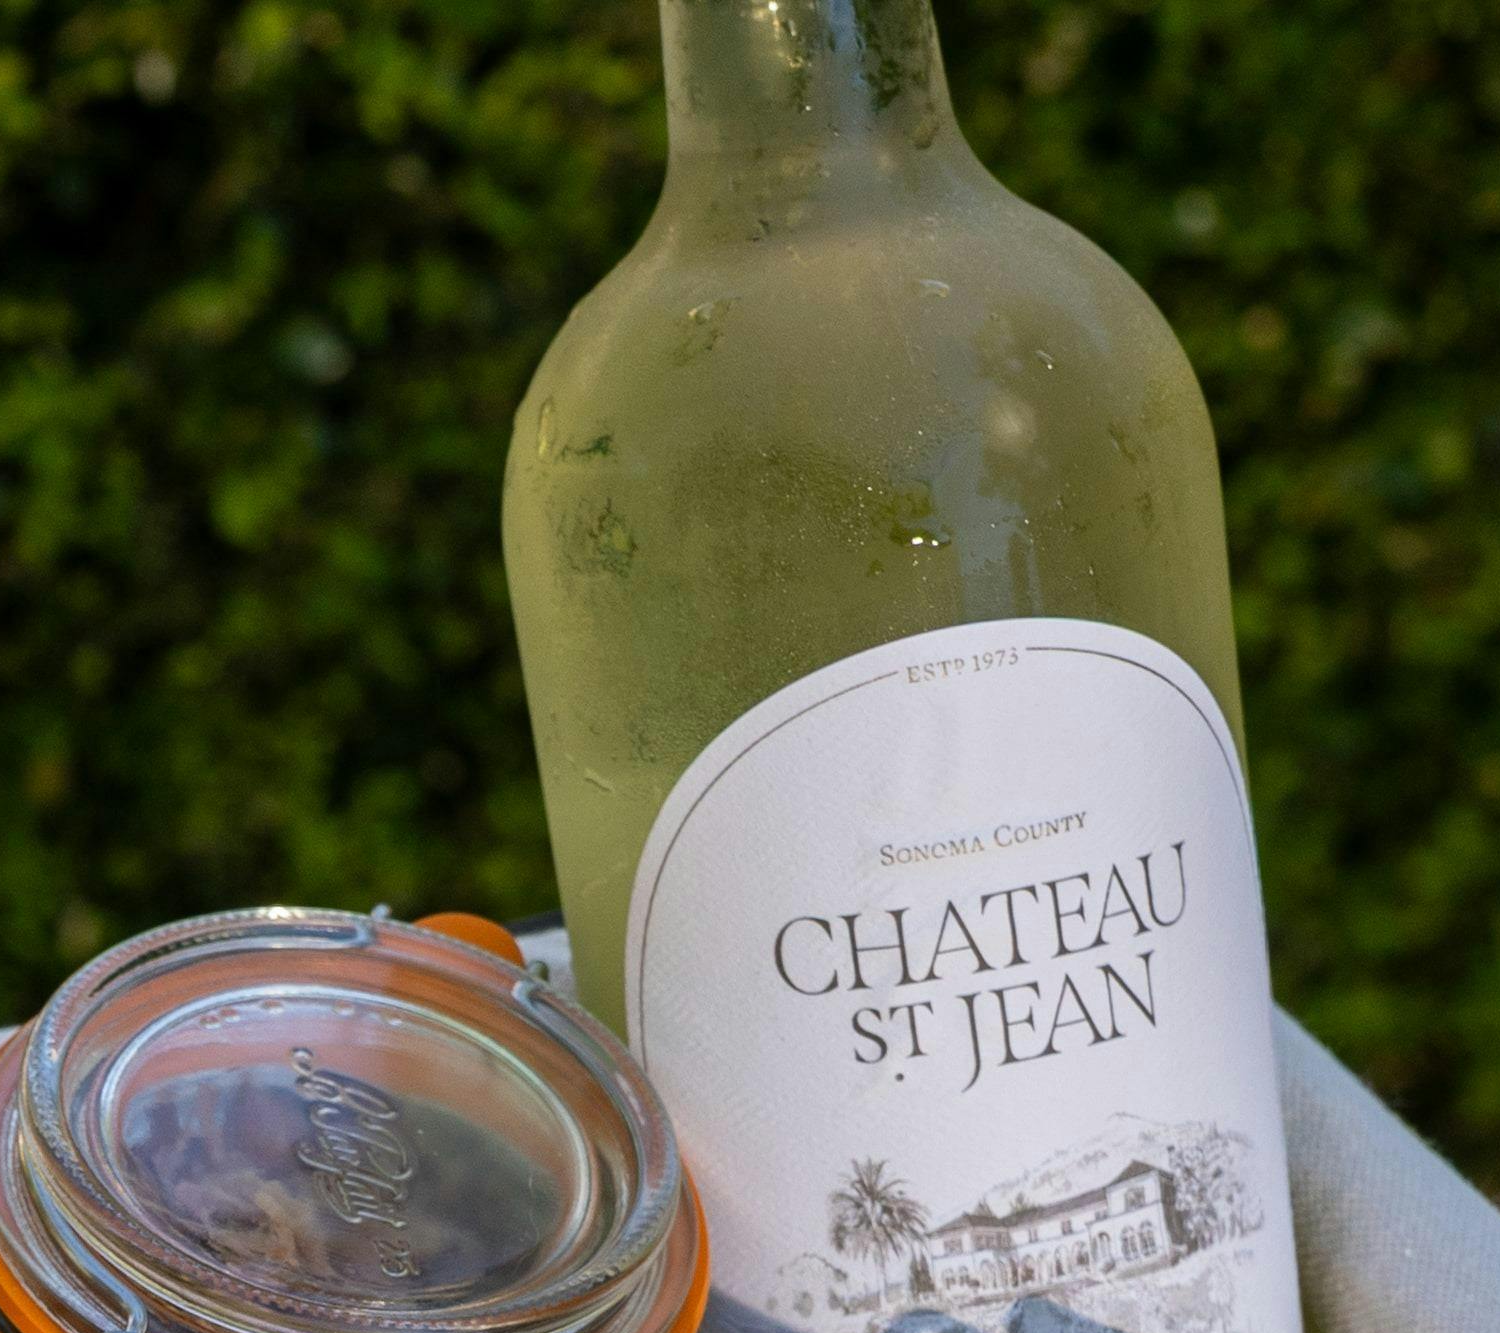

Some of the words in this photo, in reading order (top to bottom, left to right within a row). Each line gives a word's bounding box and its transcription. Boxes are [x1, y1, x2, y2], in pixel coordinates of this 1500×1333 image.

[973, 647, 1019, 673] 1973
[773, 840, 1188, 997] CHATEAU
[957, 950, 1158, 1093] JEAN
